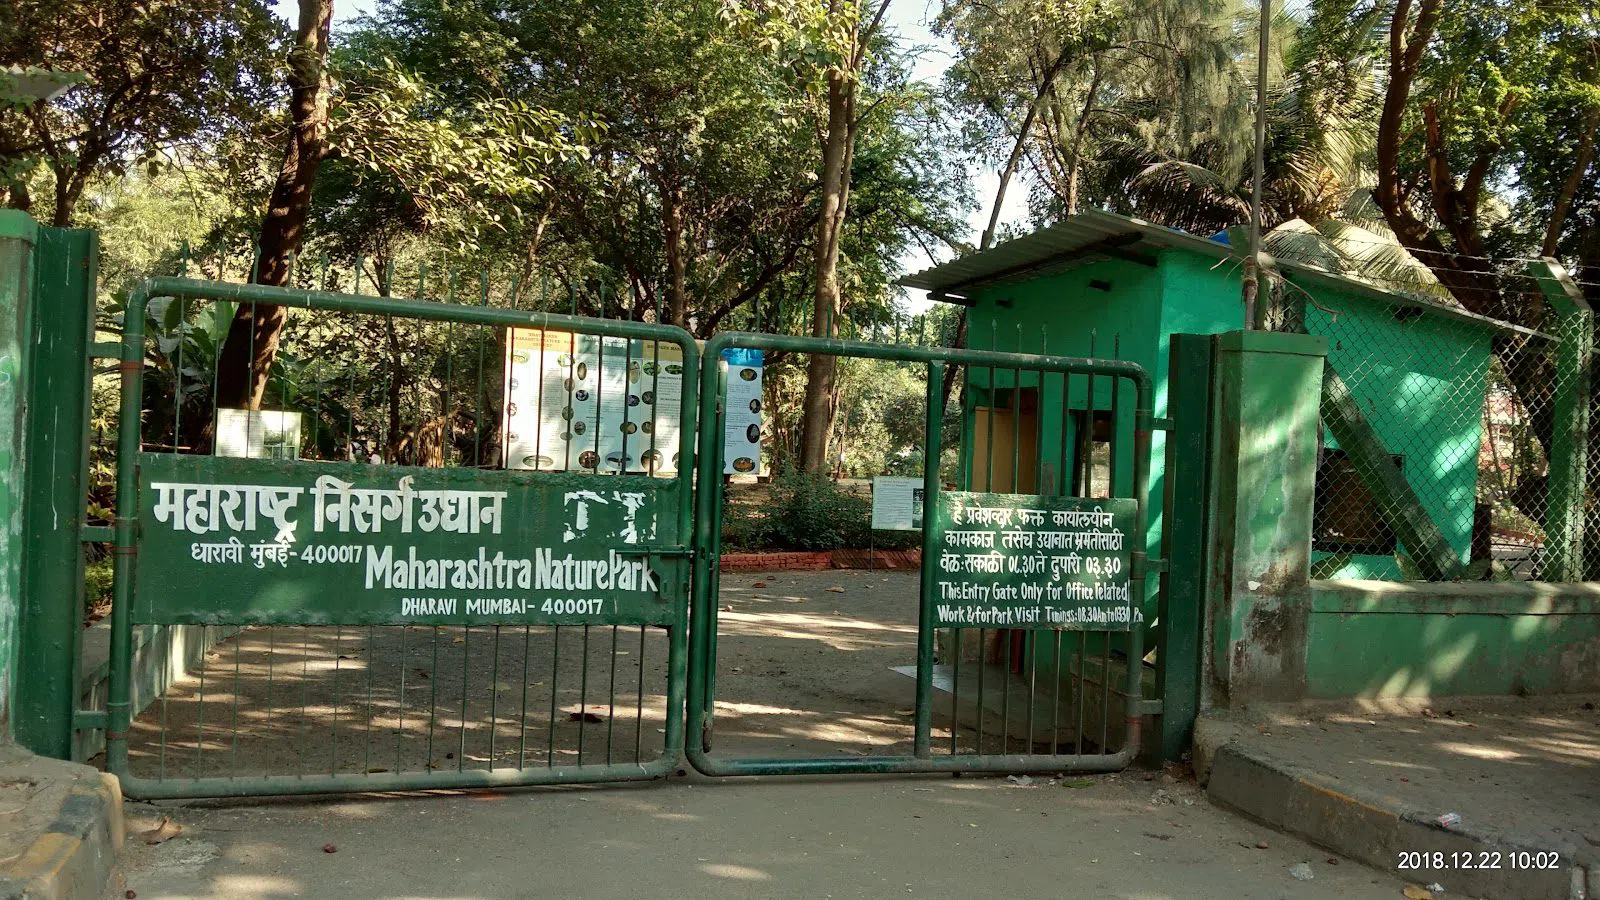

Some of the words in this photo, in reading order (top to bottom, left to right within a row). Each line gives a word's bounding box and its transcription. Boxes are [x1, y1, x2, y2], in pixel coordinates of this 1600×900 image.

[310, 474, 418, 534] निसर्ग
[191, 536, 243, 564] धारावी
[301, 545, 362, 565] 400017
[945, 530, 996, 549] कामकाज
[1001, 525, 1035, 550] तसेच
[365, 545, 532, 590] Maharashtra
[535, 548, 609, 590] Nature
[609, 549, 658, 592] Park
[1051, 552, 1083, 580] दुपारी
[402, 597, 457, 615] DHARAVI
[541, 599, 603, 615] 400017
[939, 582, 961, 599] This
[962, 582, 990, 603] Entry
[993, 582, 1017, 600] Gate
[1021, 582, 1043, 604] Only
[1046, 582, 1063, 600] for
[1066, 582, 1093, 601] Office
[937, 604, 965, 623] Work
[992, 607, 1013, 625] Park
[1015, 606, 1040, 623] Visit
